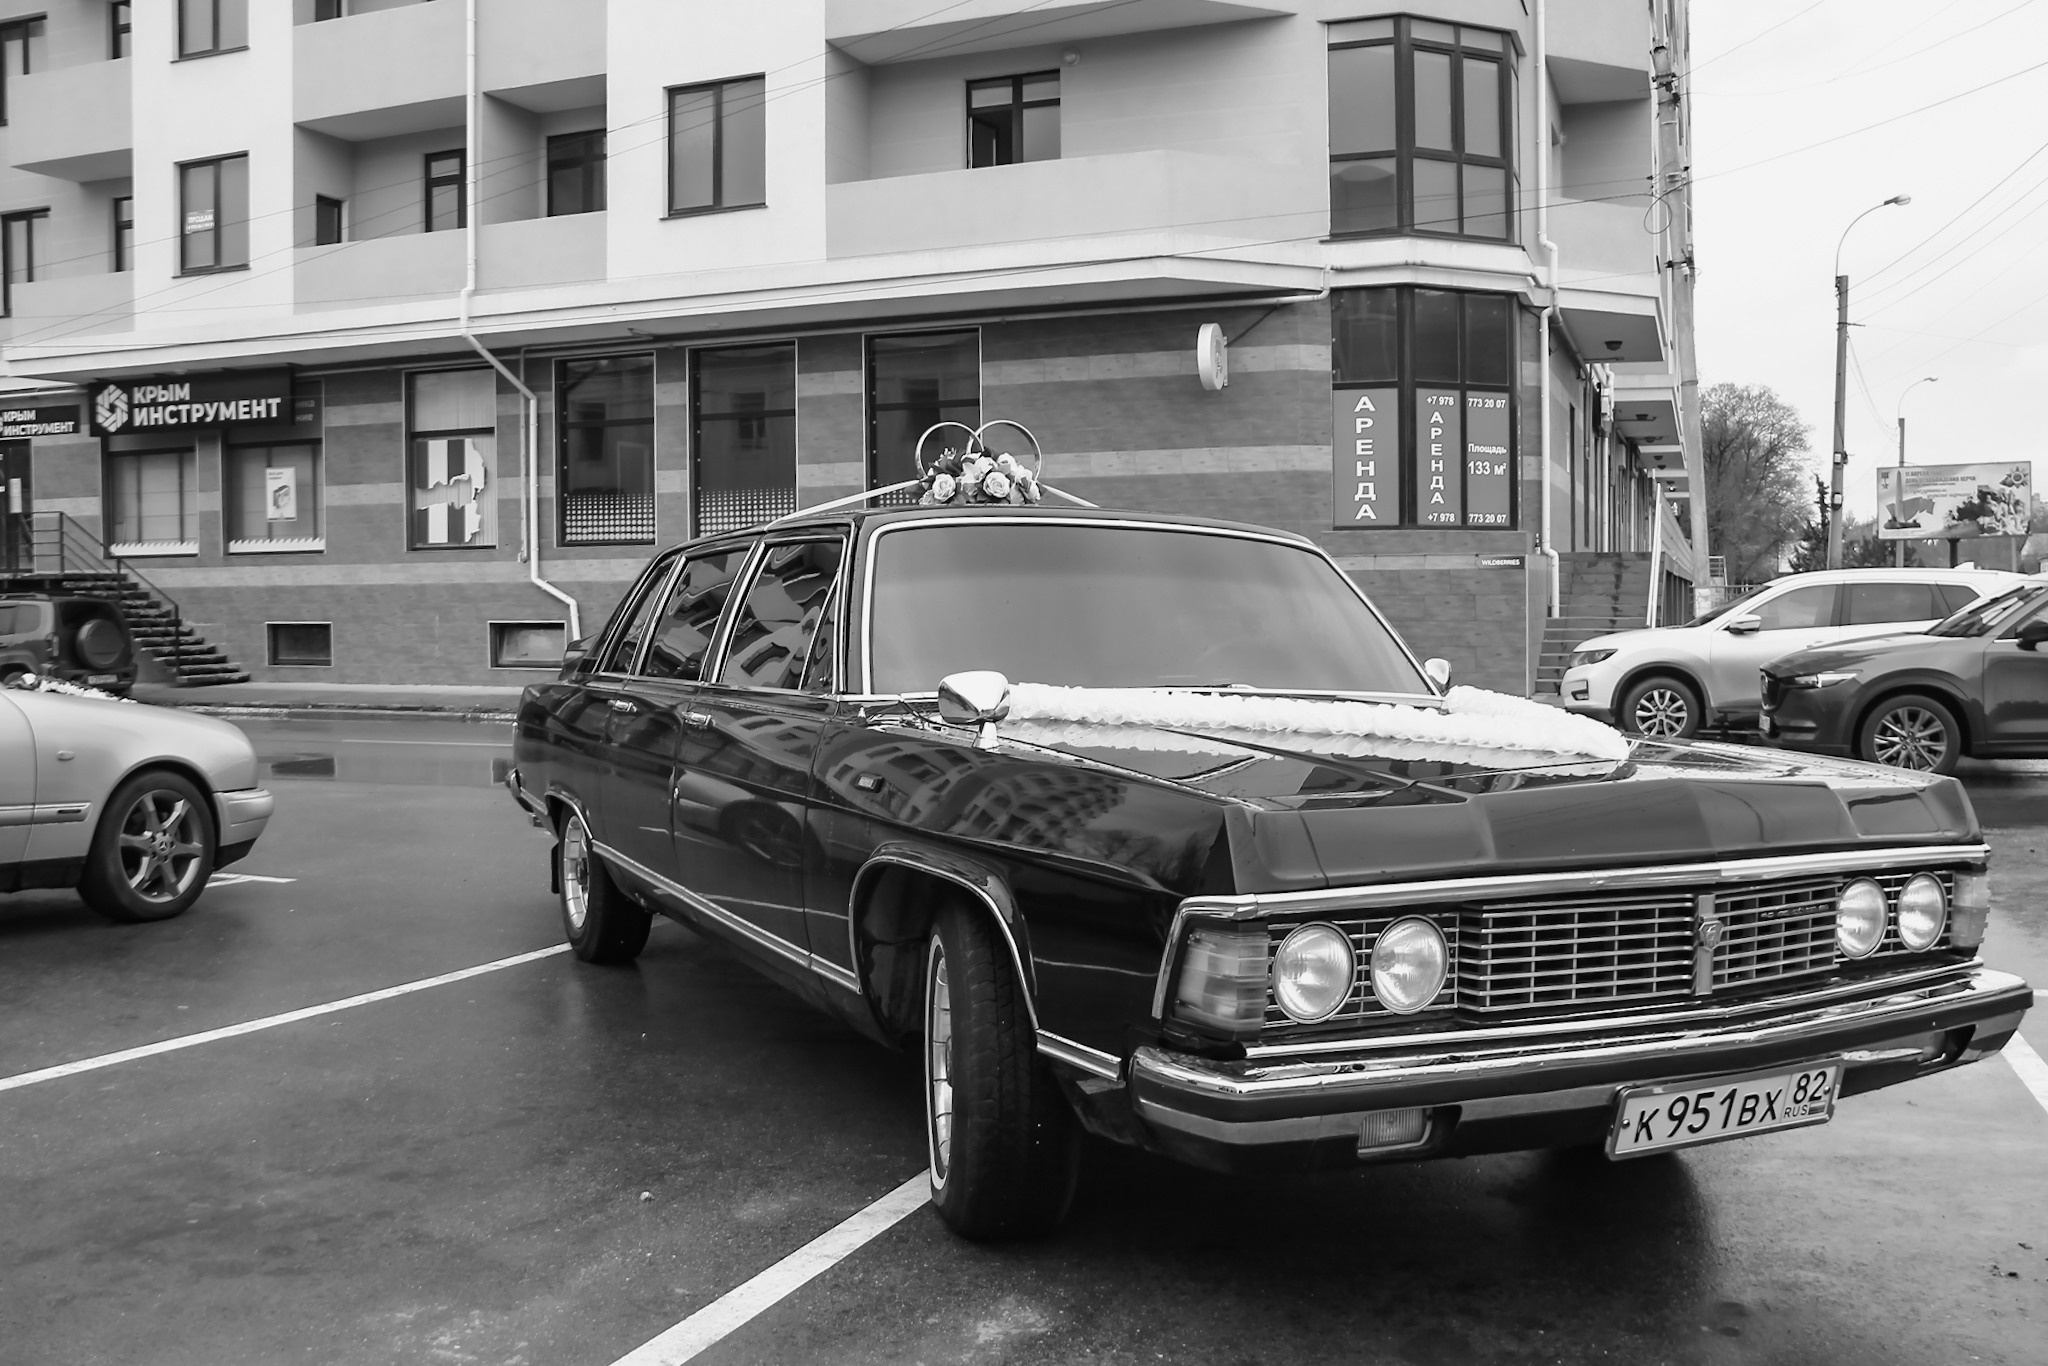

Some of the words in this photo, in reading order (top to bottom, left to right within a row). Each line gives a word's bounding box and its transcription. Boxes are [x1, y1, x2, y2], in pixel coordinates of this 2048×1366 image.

[133, 383, 191, 404] КРЫМ
[1427, 396, 1438, 405] +7
[1439, 397, 1454, 406] 978
[1468, 398, 1483, 408] 773
[1484, 399, 1494, 409] 20
[1496, 400, 1506, 409] 07
[2, 409, 37, 423] КРЫМ
[133, 397, 281, 427] ИНСТРУМЕНТ
[2, 421, 75, 436] ИНСТРУМЕНТ
[1468, 443, 1507, 455] Площадь
[1354, 396, 1377, 520] АРЕНДА
[1429, 411, 1444, 504] АРЕНДА
[1468, 461, 1491, 475] 133
[1428, 514, 1439, 522] +7
[1439, 513, 1455, 523] 978
[1469, 514, 1483, 523] 773
[1485, 514, 1495, 523] 20
[1497, 514, 1506, 523] 07
[1793, 1070, 1828, 1104] 82
[1783, 1103, 1808, 1118] RUS
